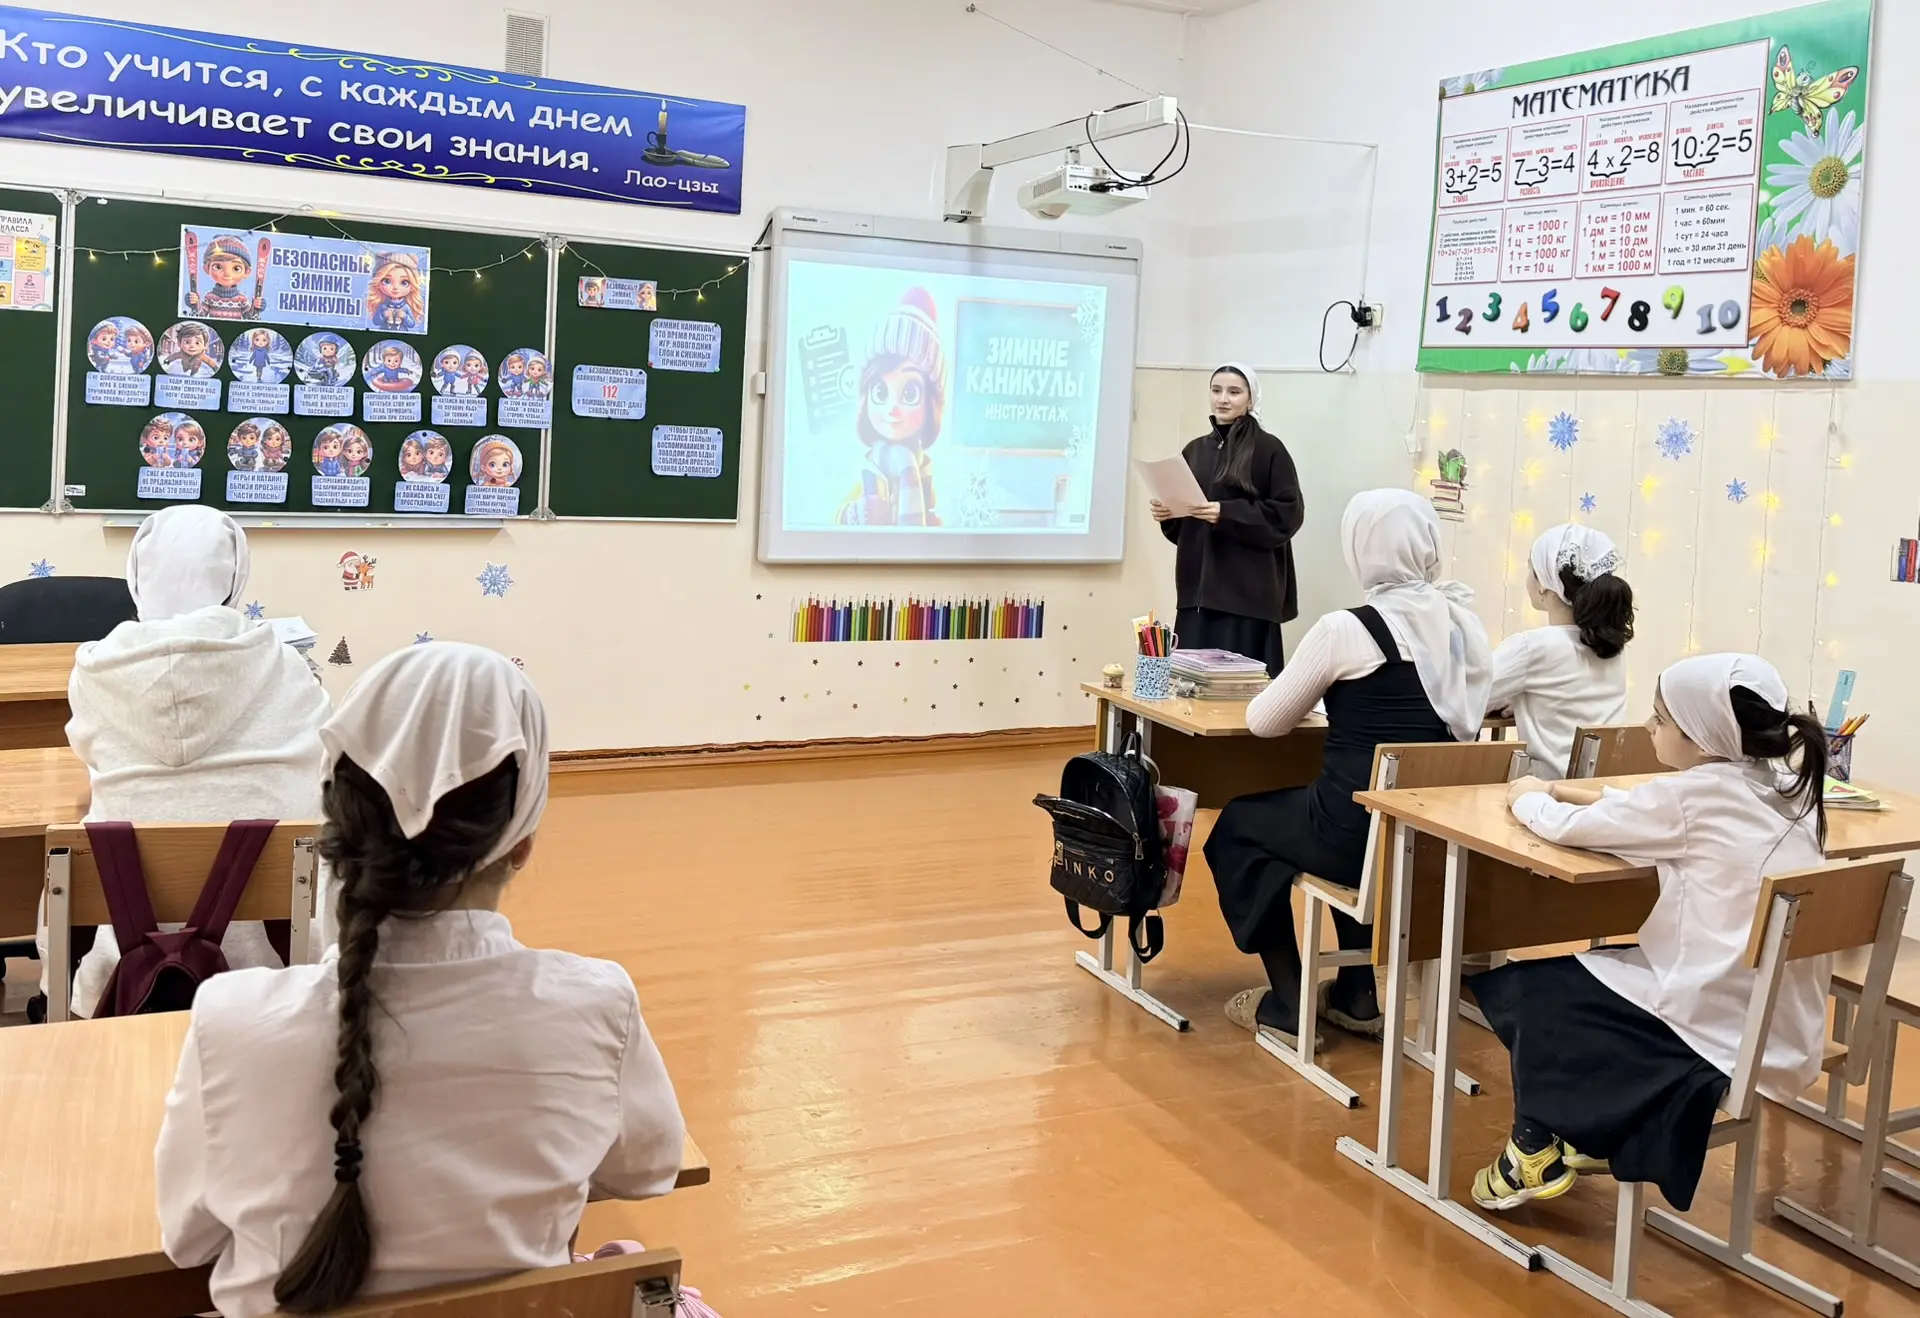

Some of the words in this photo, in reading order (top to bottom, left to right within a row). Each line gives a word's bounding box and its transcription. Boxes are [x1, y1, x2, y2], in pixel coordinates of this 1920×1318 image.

[0, 34, 88, 69] Кто
[104, 50, 284, 98] учится,
[300, 76, 323, 98] с
[340, 80, 515, 123] каждым
[529, 106, 633, 138] днем
[1512, 65, 1691, 119] МАТЕМАТИКА
[0, 86, 313, 141] увеличивает
[328, 122, 433, 153] свои
[449, 138, 600, 174] знания.
[1672, 129, 1752, 160] 10:2=5
[625, 170, 720, 196] Лао-цзы
[1446, 162, 1501, 188] 3+2=5
[1706, 204, 1713, 212] 60
[1508, 224, 1512, 233] 1
[1516, 224, 1525, 233] кг
[1538, 220, 1560, 231] 1000
[1587, 215, 1591, 224] 1
[1595, 215, 1608, 224] см
[1621, 212, 1631, 221] 10
[1635, 212, 1650, 220] мм
[1583, 228, 1587, 237] 1
[1590, 227, 1604, 237] дм
[1620, 224, 1630, 234] 10
[1634, 225, 1647, 233] см
[1508, 238, 1511, 247] 1
[1537, 235, 1553, 245] 100
[1556, 235, 1566, 244] кг
[1592, 239, 1595, 248] 1
[1620, 236, 1630, 246] 10
[1633, 237, 1647, 246] дм
[1510, 251, 1514, 260] 1
[1535, 248, 1557, 259] 1000
[1560, 249, 1570, 258] кг
[1591, 251, 1595, 260] 1
[1619, 248, 1635, 259] 100
[1639, 249, 1652, 257] см
[1703, 257, 1734, 265] месяцев
[1509, 265, 1513, 274] 1
[1535, 263, 1544, 273] 10
[1585, 264, 1588, 272] 1
[1592, 264, 1604, 272] км
[1618, 261, 1639, 271] 1000
[292, 273, 350, 293] ЗИМНИЕ
[279, 293, 361, 315] КАНИКУЛЫ
[1436, 296, 1450, 322] 1
[1455, 308, 1473, 335] 2
[1483, 292, 1502, 321] 3
[1512, 302, 1530, 332] 4
[1541, 289, 1559, 322] 5
[1569, 302, 1588, 332] 6
[1601, 287, 1621, 321] 7
[1628, 301, 1650, 331] 8
[1662, 285, 1684, 319] 9
[1697, 300, 1740, 335] 10
[986, 337, 1069, 368] ЗИМНИЕ
[603, 385, 617, 398] 112
[966, 365, 1085, 399] КАНИКУЛЫ
[985, 403, 1069, 422] ИНСТРУКТАЖ
[1053, 856, 1114, 882] PINKO
